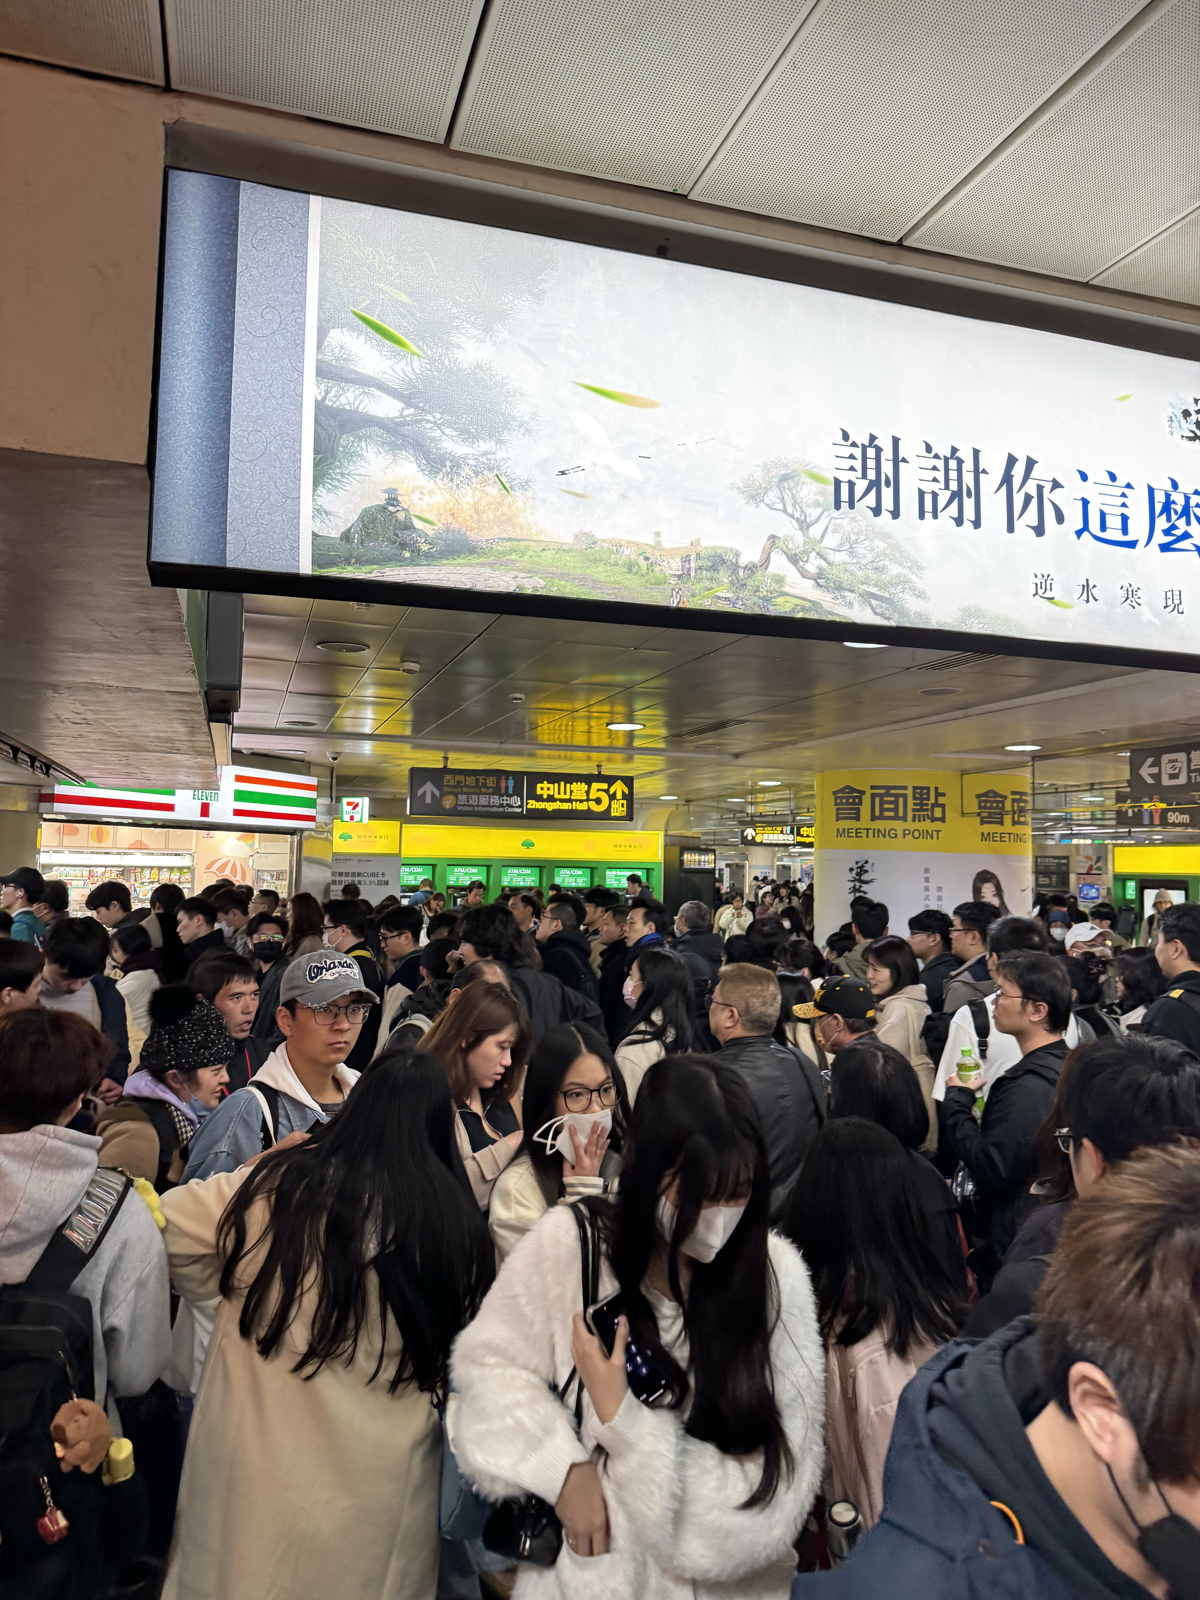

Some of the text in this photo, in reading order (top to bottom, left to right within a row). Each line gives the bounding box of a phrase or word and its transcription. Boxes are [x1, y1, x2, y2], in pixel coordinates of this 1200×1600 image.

[832, 427, 1200, 559] 謝謝你這麼
[443, 774, 497, 787] 西門地下街
[536, 781, 588, 799] 中山堂
[457, 794, 522, 806] 旅遊服務中心
[588, 783, 610, 812] 5
[832, 785, 946, 823] 會面點
[527, 800, 588, 811] Zhongshan Hall
[1167, 812, 1190, 823] 90m
[836, 828, 942, 840] MEETING POINT
[981, 832, 1027, 843] MEETING
[307, 959, 355, 981] Orlando
